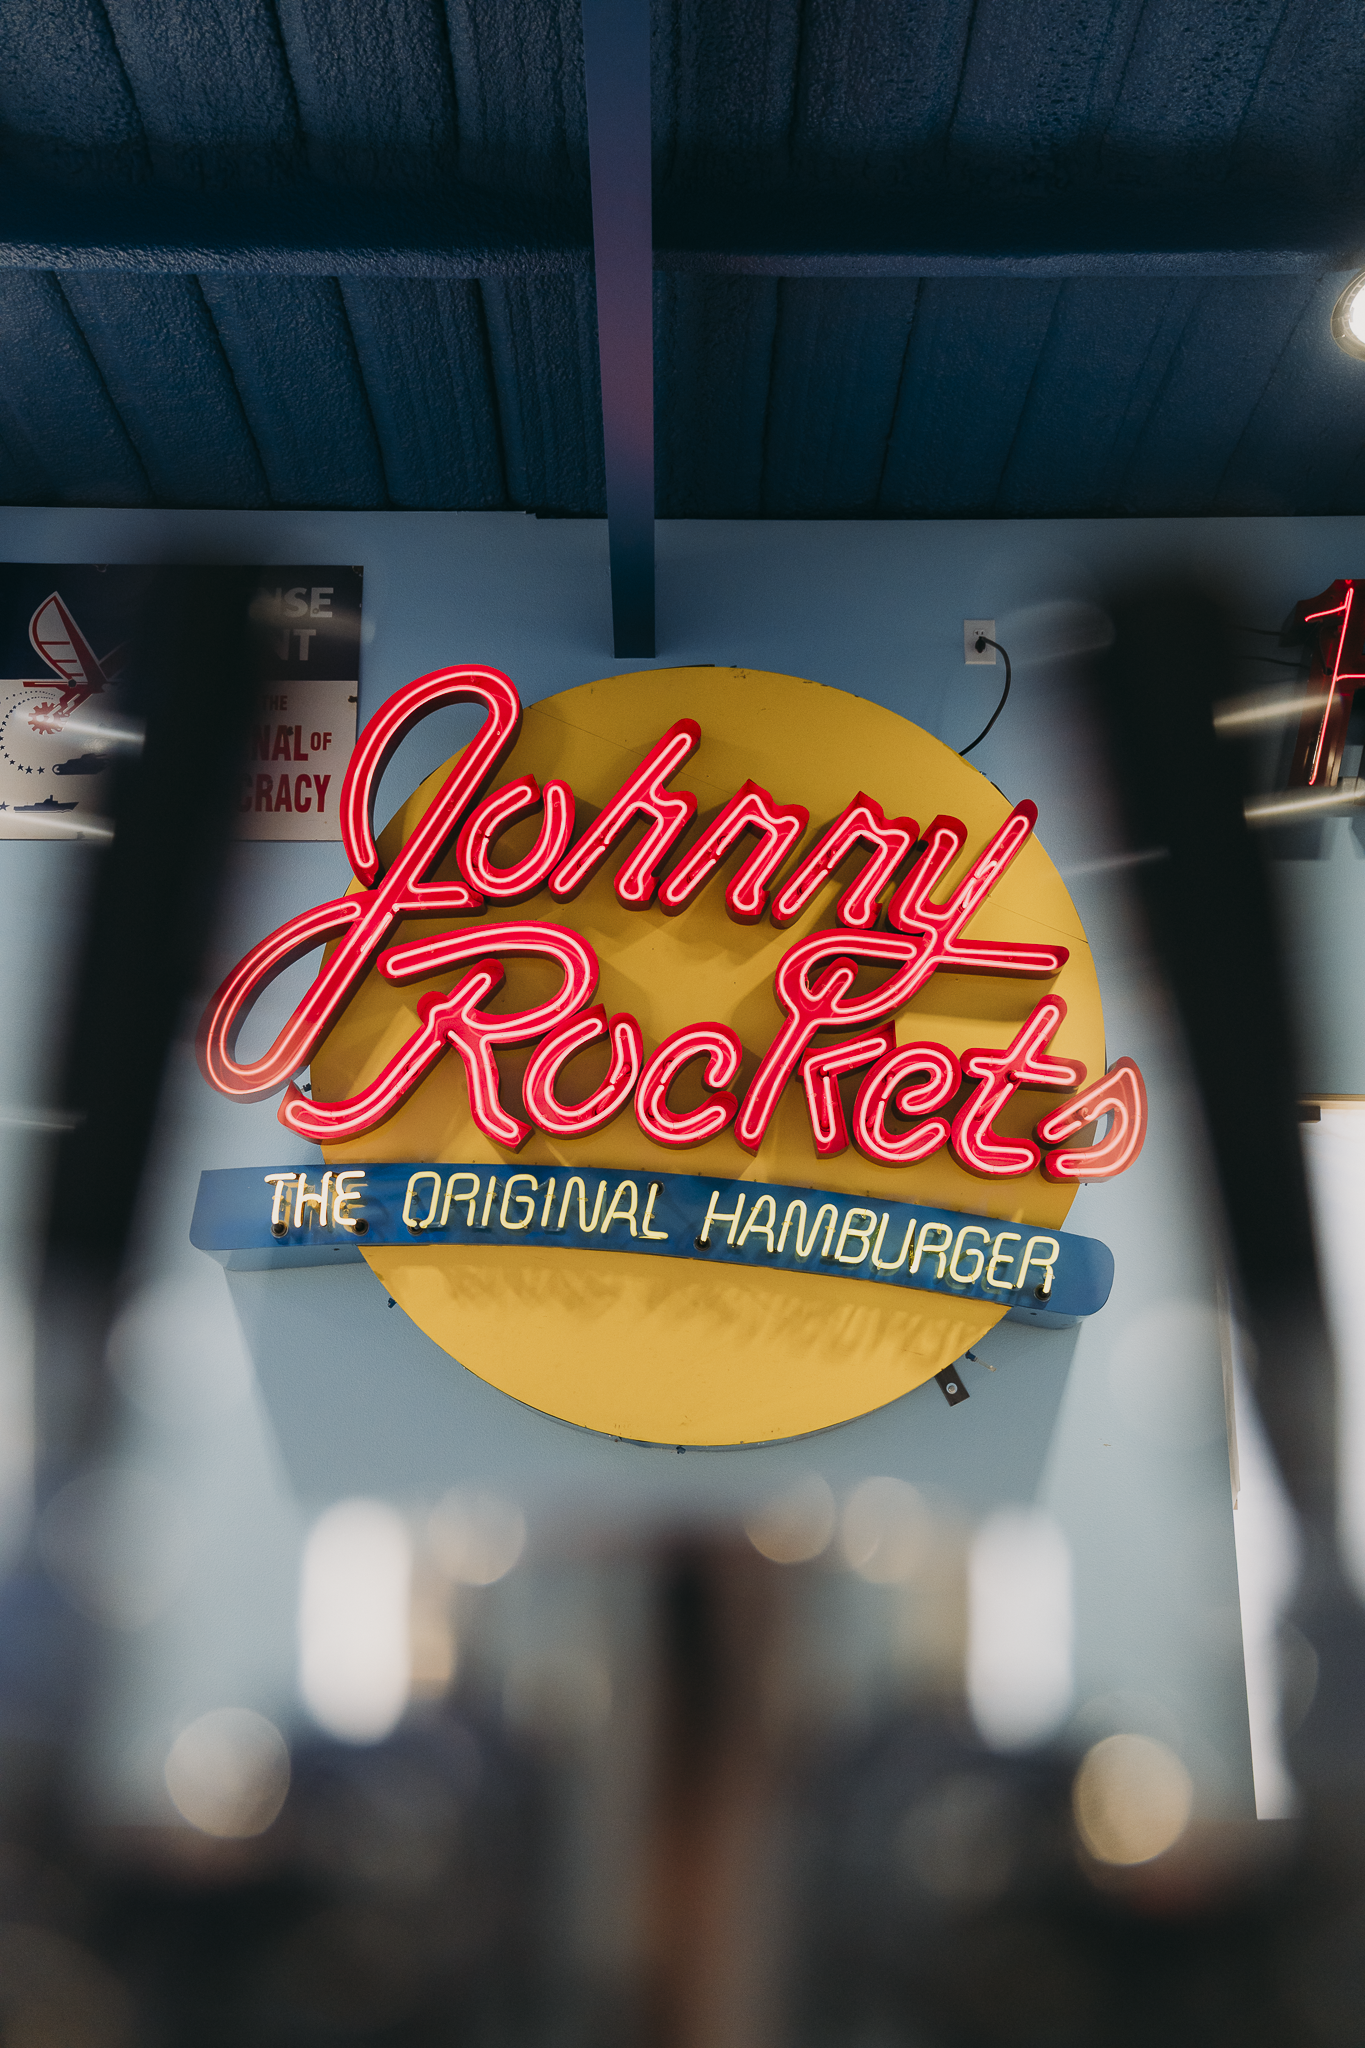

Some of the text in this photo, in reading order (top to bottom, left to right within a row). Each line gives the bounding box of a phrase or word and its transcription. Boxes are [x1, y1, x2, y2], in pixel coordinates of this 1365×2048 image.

[310, 732, 332, 751] OF
[198, 663, 1070, 1102] Johnny
[278, 922, 1149, 1183] Rockets
[264, 1171, 1061, 1293] THE ORIGINAL HAMBURGER
